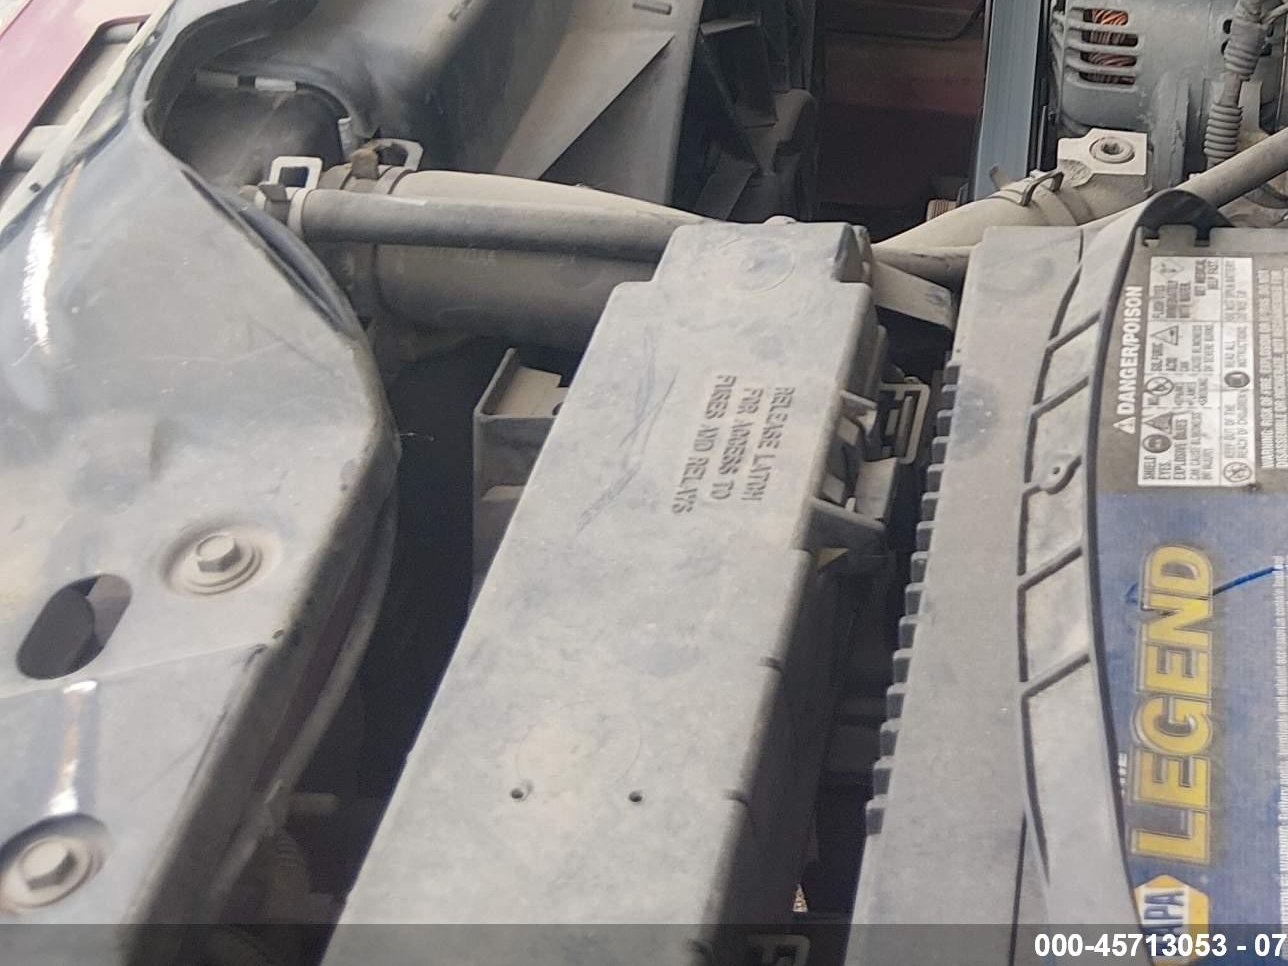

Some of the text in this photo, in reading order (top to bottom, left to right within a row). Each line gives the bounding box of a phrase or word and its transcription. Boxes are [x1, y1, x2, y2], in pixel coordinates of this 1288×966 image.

[1116, 285, 1144, 415] DANGER/POISON
[671, 375, 738, 515] FUSES AND RELAYS
[710, 388, 765, 501] FOR ACCESS TO
[741, 386, 796, 501] RELEASE LATCH
[1143, 455, 1157, 481] SHIELD
[1174, 443, 1187, 481] EXPLOSIVE
[1129, 543, 1212, 865] LEGEND
